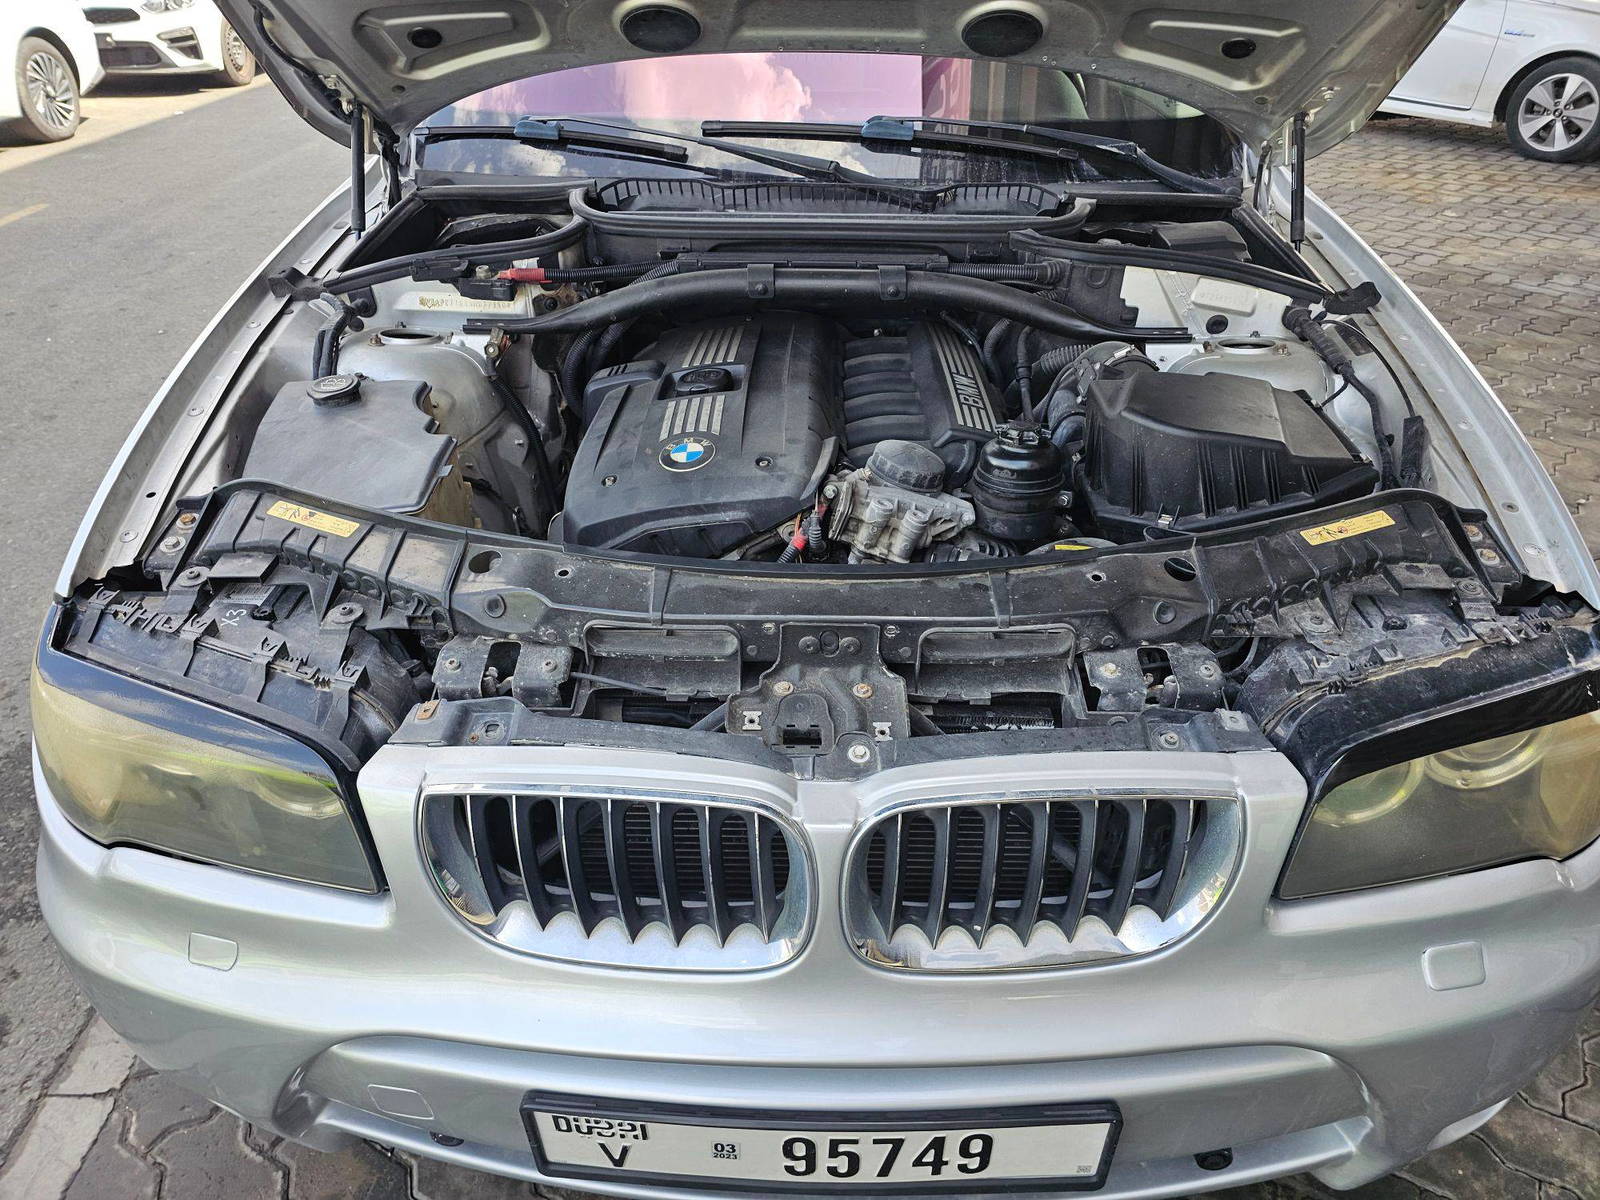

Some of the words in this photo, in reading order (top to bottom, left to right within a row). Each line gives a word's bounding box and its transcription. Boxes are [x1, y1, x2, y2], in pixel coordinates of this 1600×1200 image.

[952, 372, 985, 409] BMW
[220, 609, 247, 626] X3
[597, 1141, 631, 1168] V
[712, 1152, 738, 1160] 2023
[713, 1142, 737, 1154] 03
[781, 1133, 994, 1178] 95749
